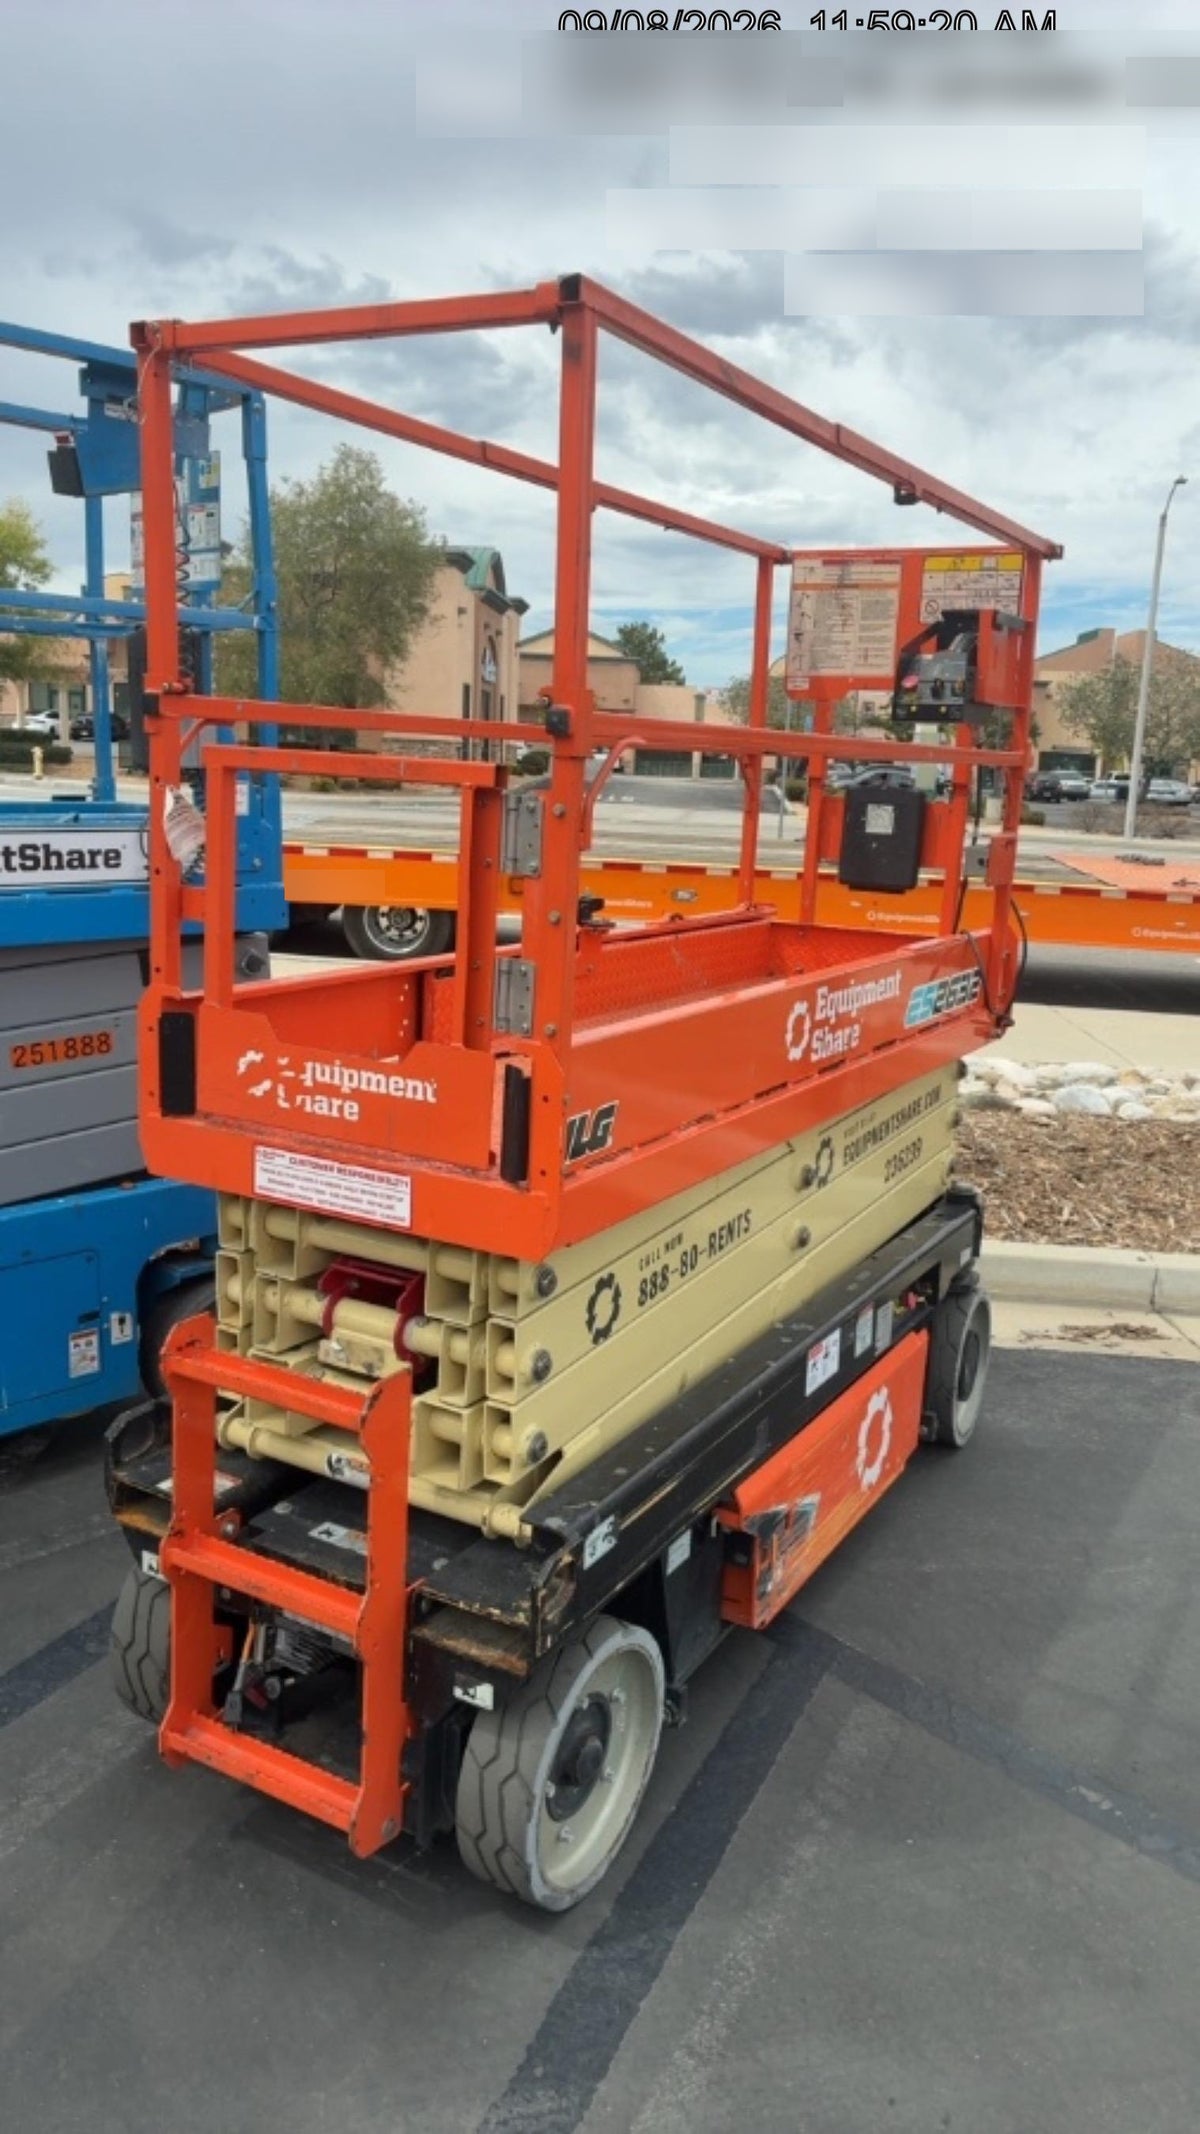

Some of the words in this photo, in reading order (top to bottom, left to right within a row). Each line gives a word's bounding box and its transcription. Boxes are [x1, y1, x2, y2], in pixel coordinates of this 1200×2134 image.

[815, 970, 902, 1024] Equipment
[13, 1031, 113, 1069] 251888
[811, 1022, 860, 1063] Share
[638, 1208, 752, 1308] 888-80-RENTS
